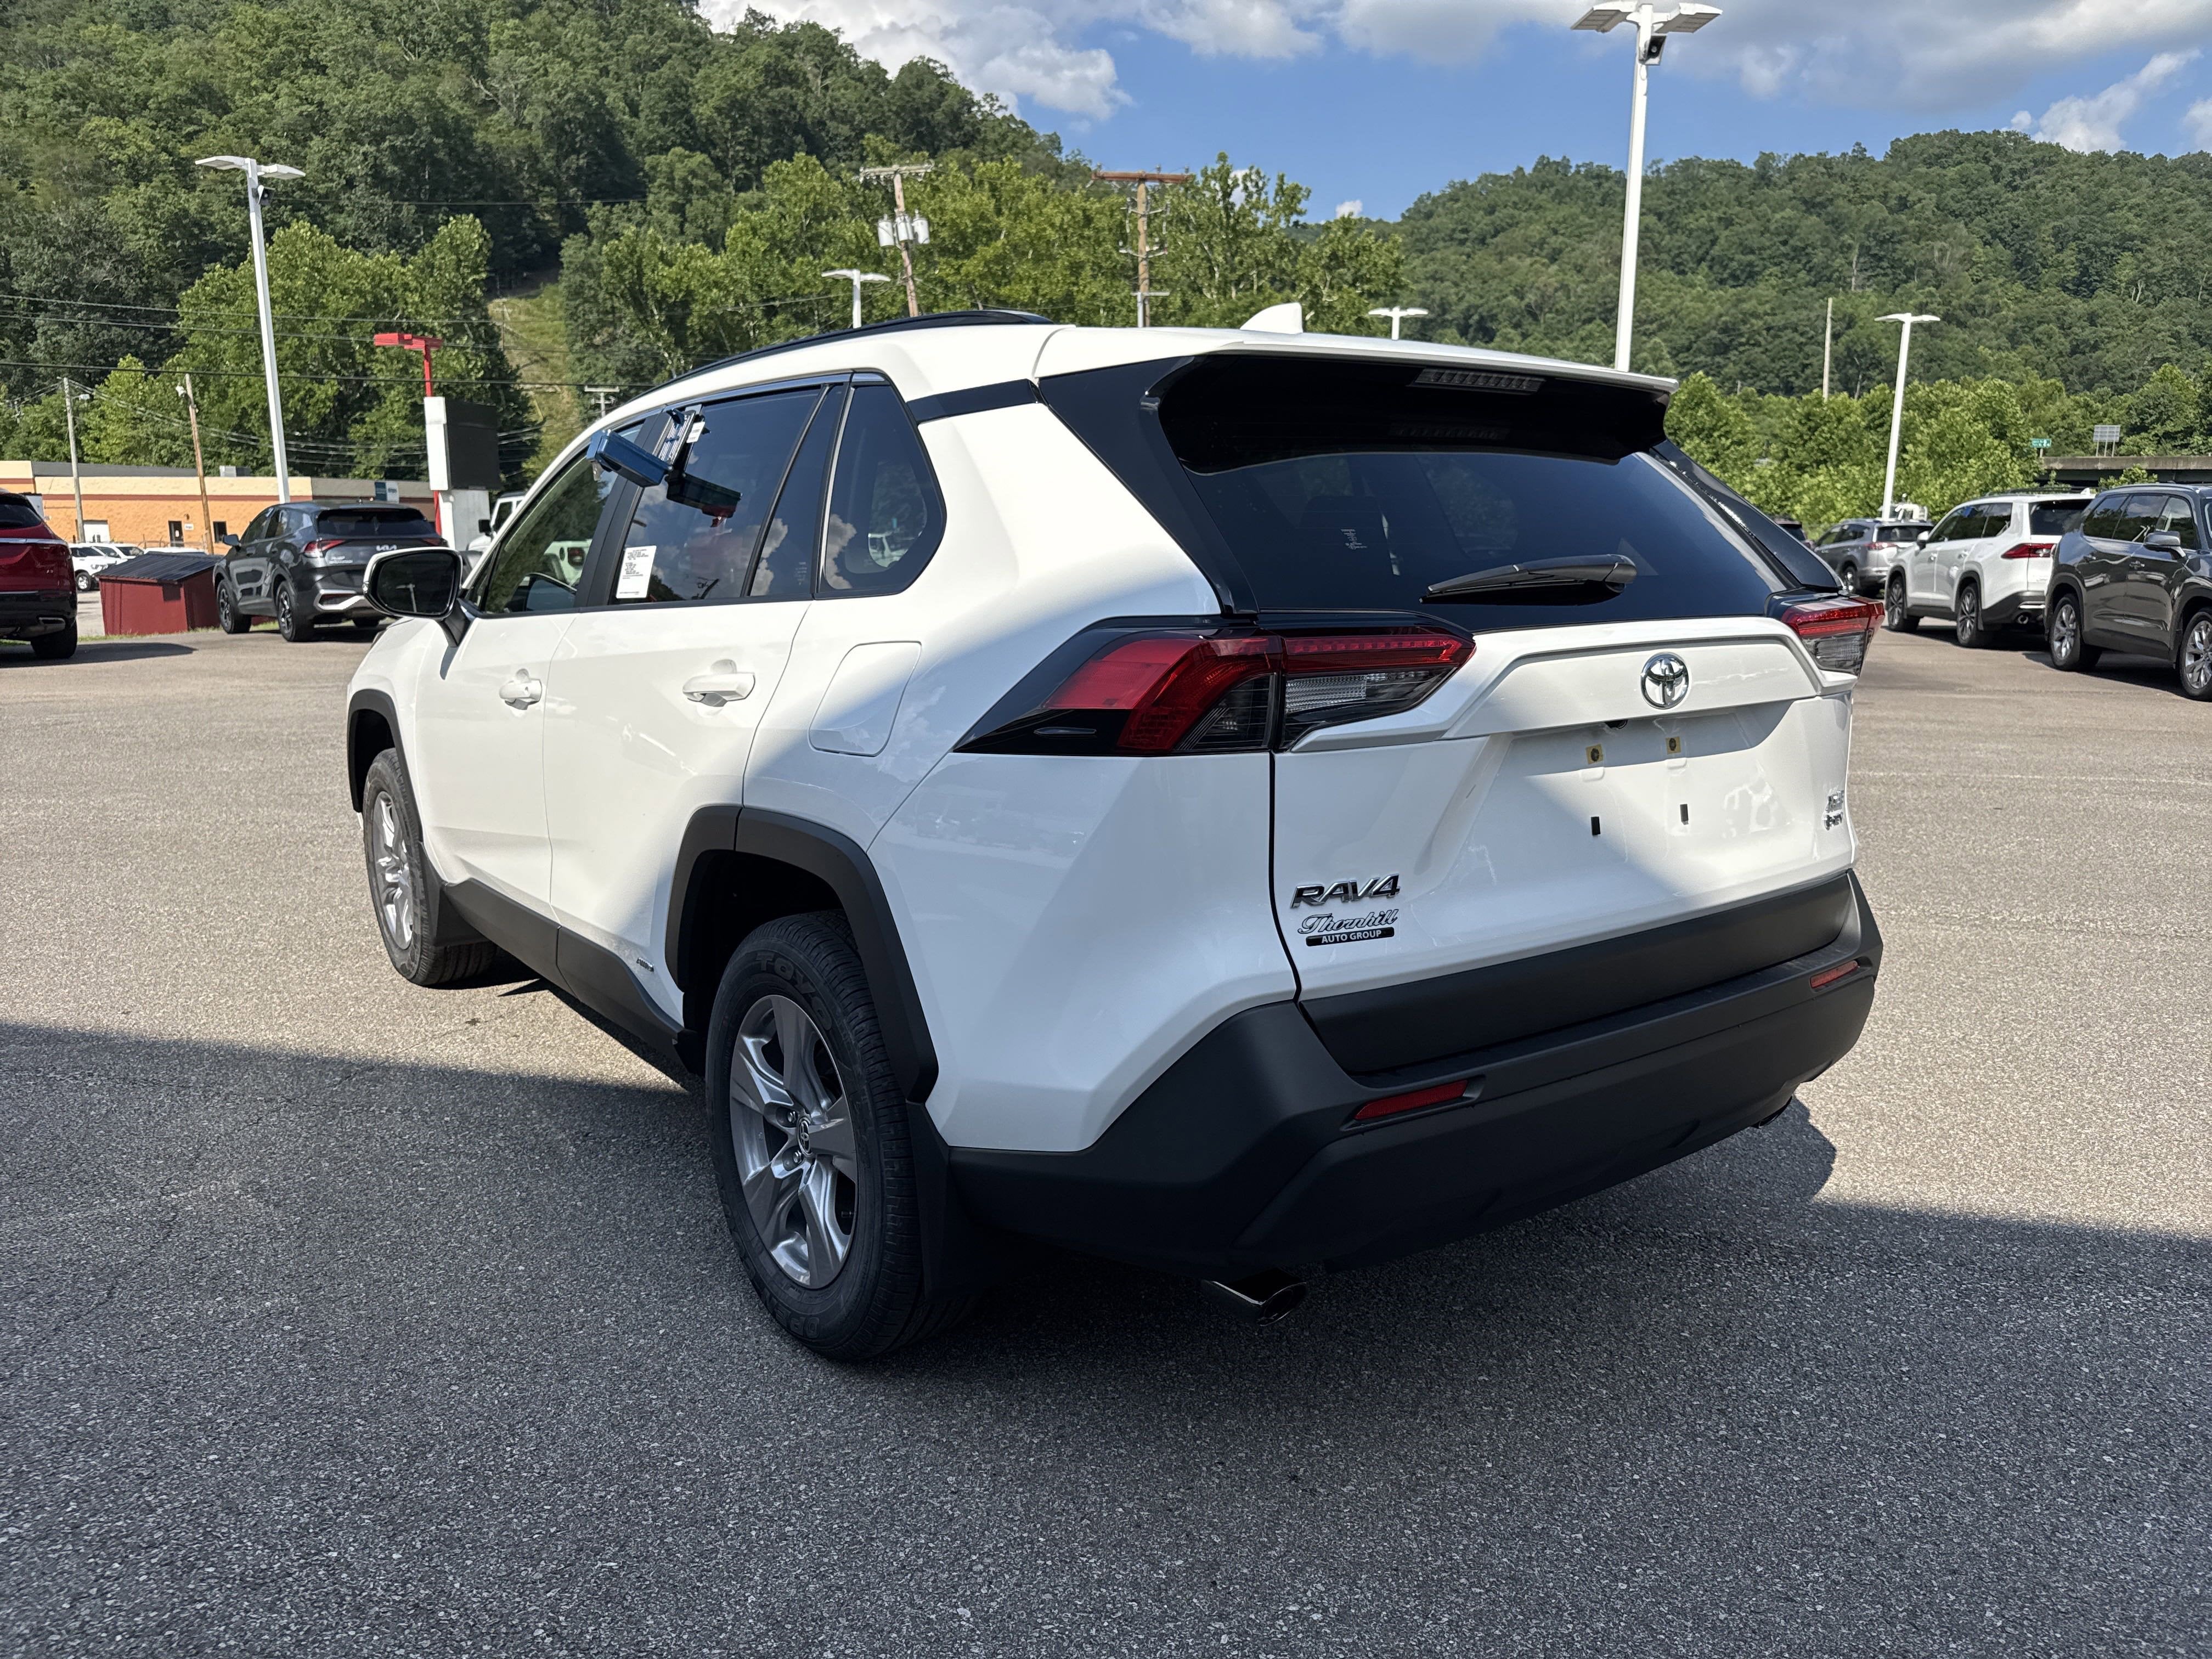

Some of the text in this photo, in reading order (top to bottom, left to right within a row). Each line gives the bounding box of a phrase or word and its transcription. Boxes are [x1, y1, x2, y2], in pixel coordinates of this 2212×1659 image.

[1290, 873, 1401, 909] RAV4
[1297, 909, 1399, 934] Thornhill
[1321, 929, 1382, 944] AUTO GROUP
[755, 952, 833, 1031] TOYO
